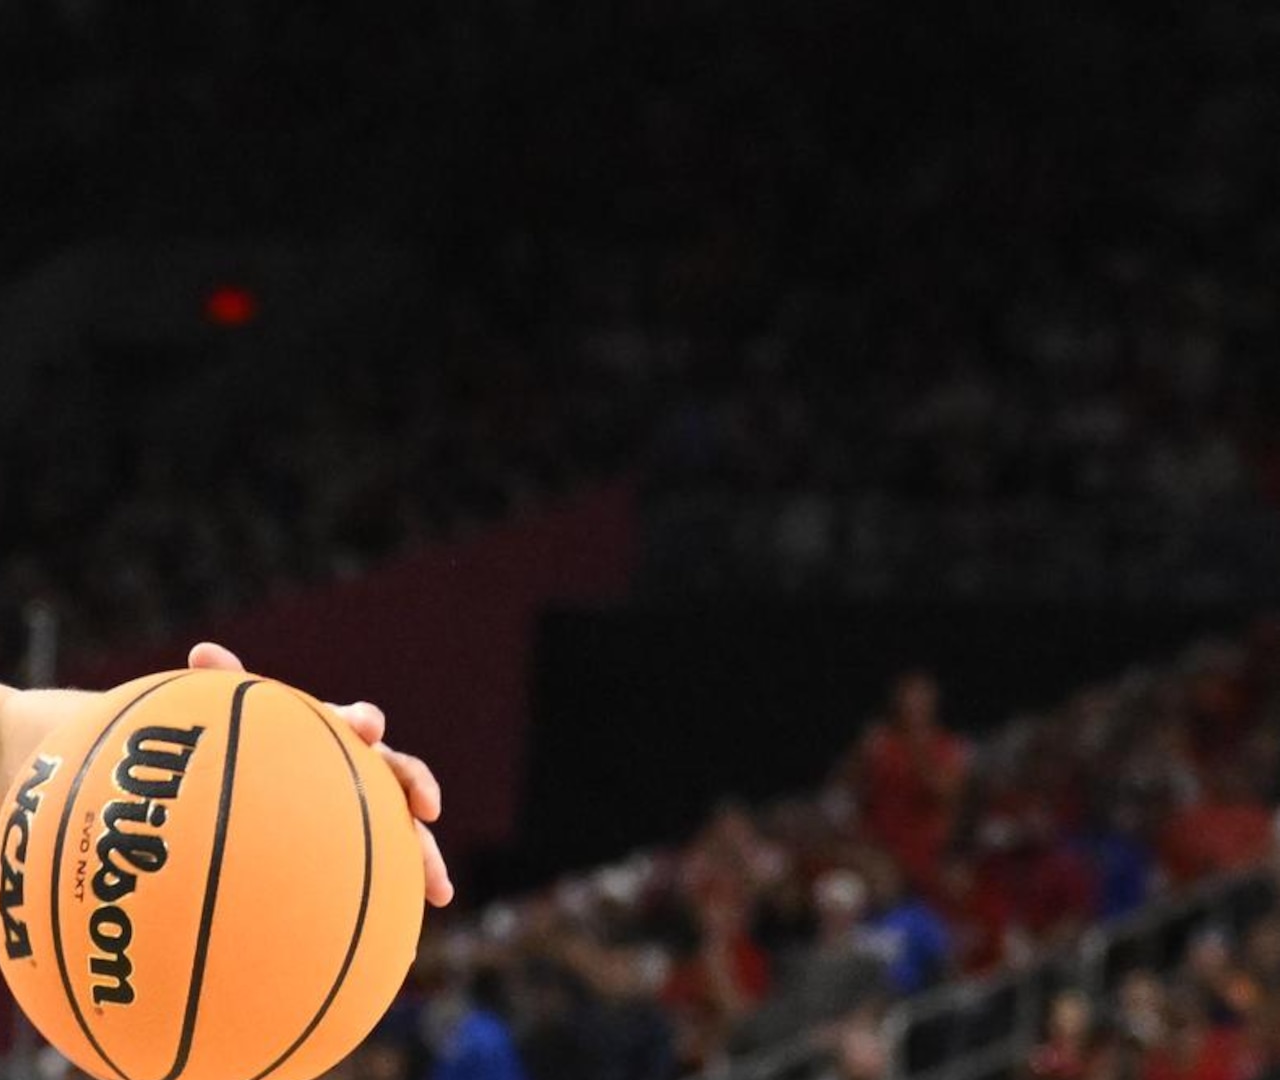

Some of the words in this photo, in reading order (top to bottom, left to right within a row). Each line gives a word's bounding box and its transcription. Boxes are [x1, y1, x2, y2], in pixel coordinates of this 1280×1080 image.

[80, 811, 95, 853] EVO
[74, 860, 87, 903] NXT
[89, 725, 206, 1005] Wilson
